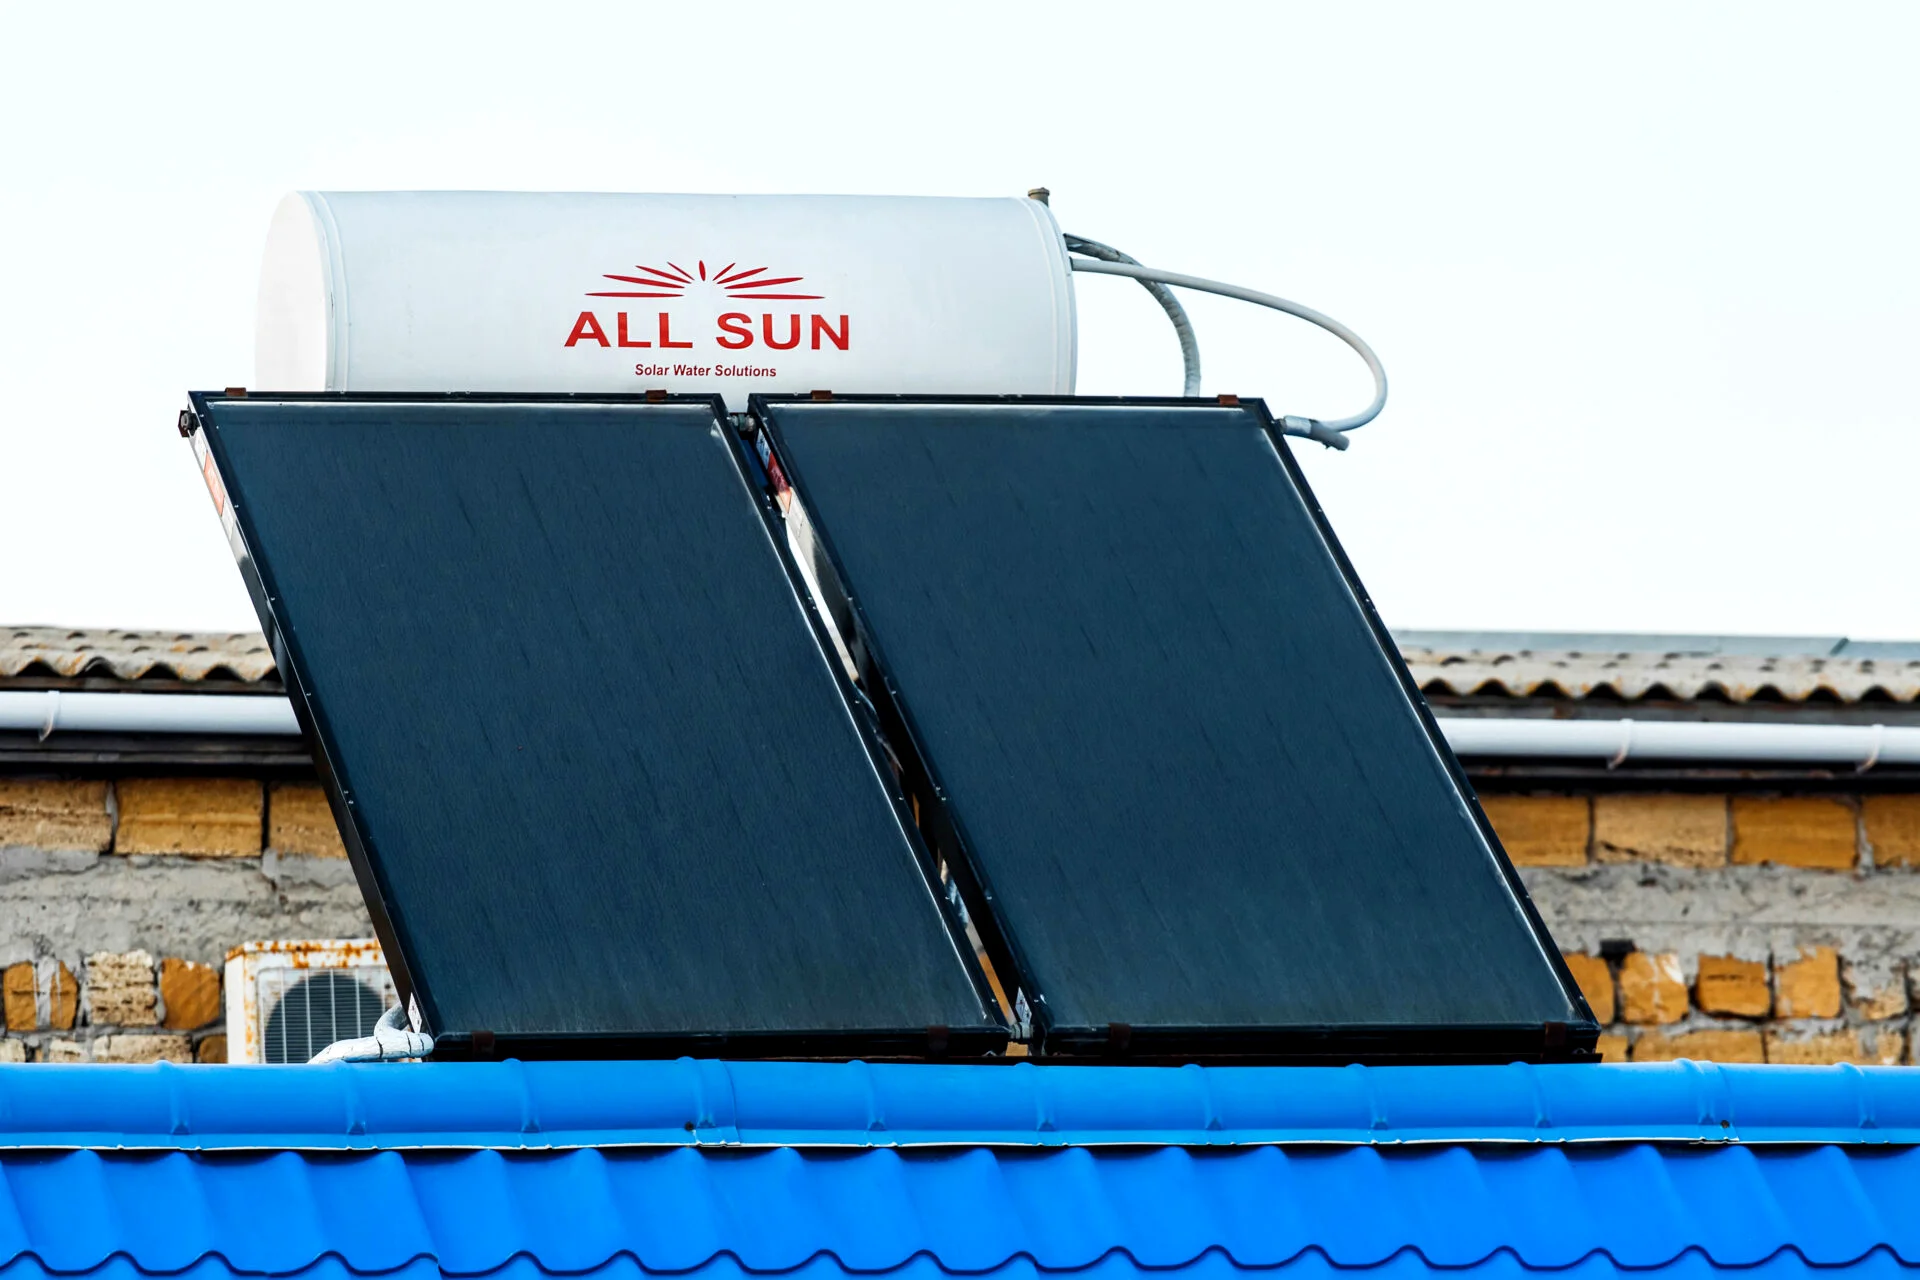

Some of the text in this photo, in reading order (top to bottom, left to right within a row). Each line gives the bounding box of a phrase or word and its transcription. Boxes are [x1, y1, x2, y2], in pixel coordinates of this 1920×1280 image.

[564, 311, 849, 350] ALL SUN
[635, 363, 777, 377] Solar Water Solutions
